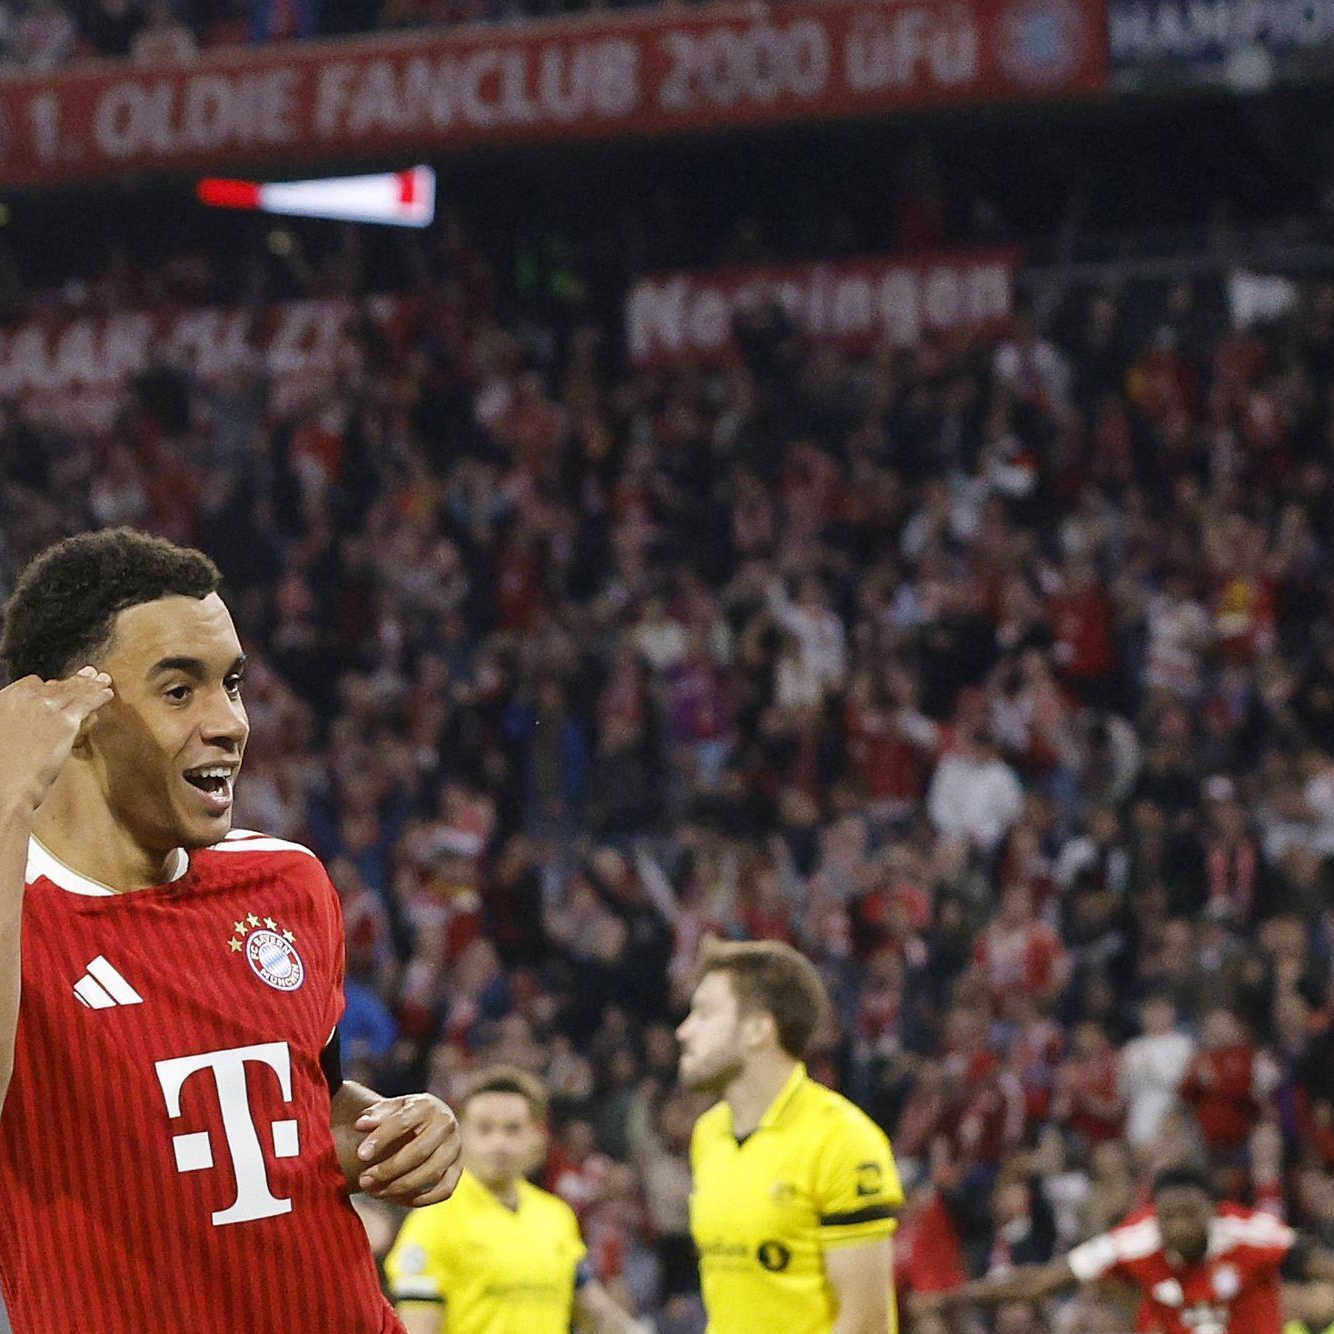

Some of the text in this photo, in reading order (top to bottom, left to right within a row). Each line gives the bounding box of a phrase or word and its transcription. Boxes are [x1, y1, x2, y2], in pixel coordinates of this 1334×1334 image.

[95, 72, 295, 158] OLDIE
[317, 34, 639, 137] FANCLUB
[253, 933, 291, 955] BAYERN
